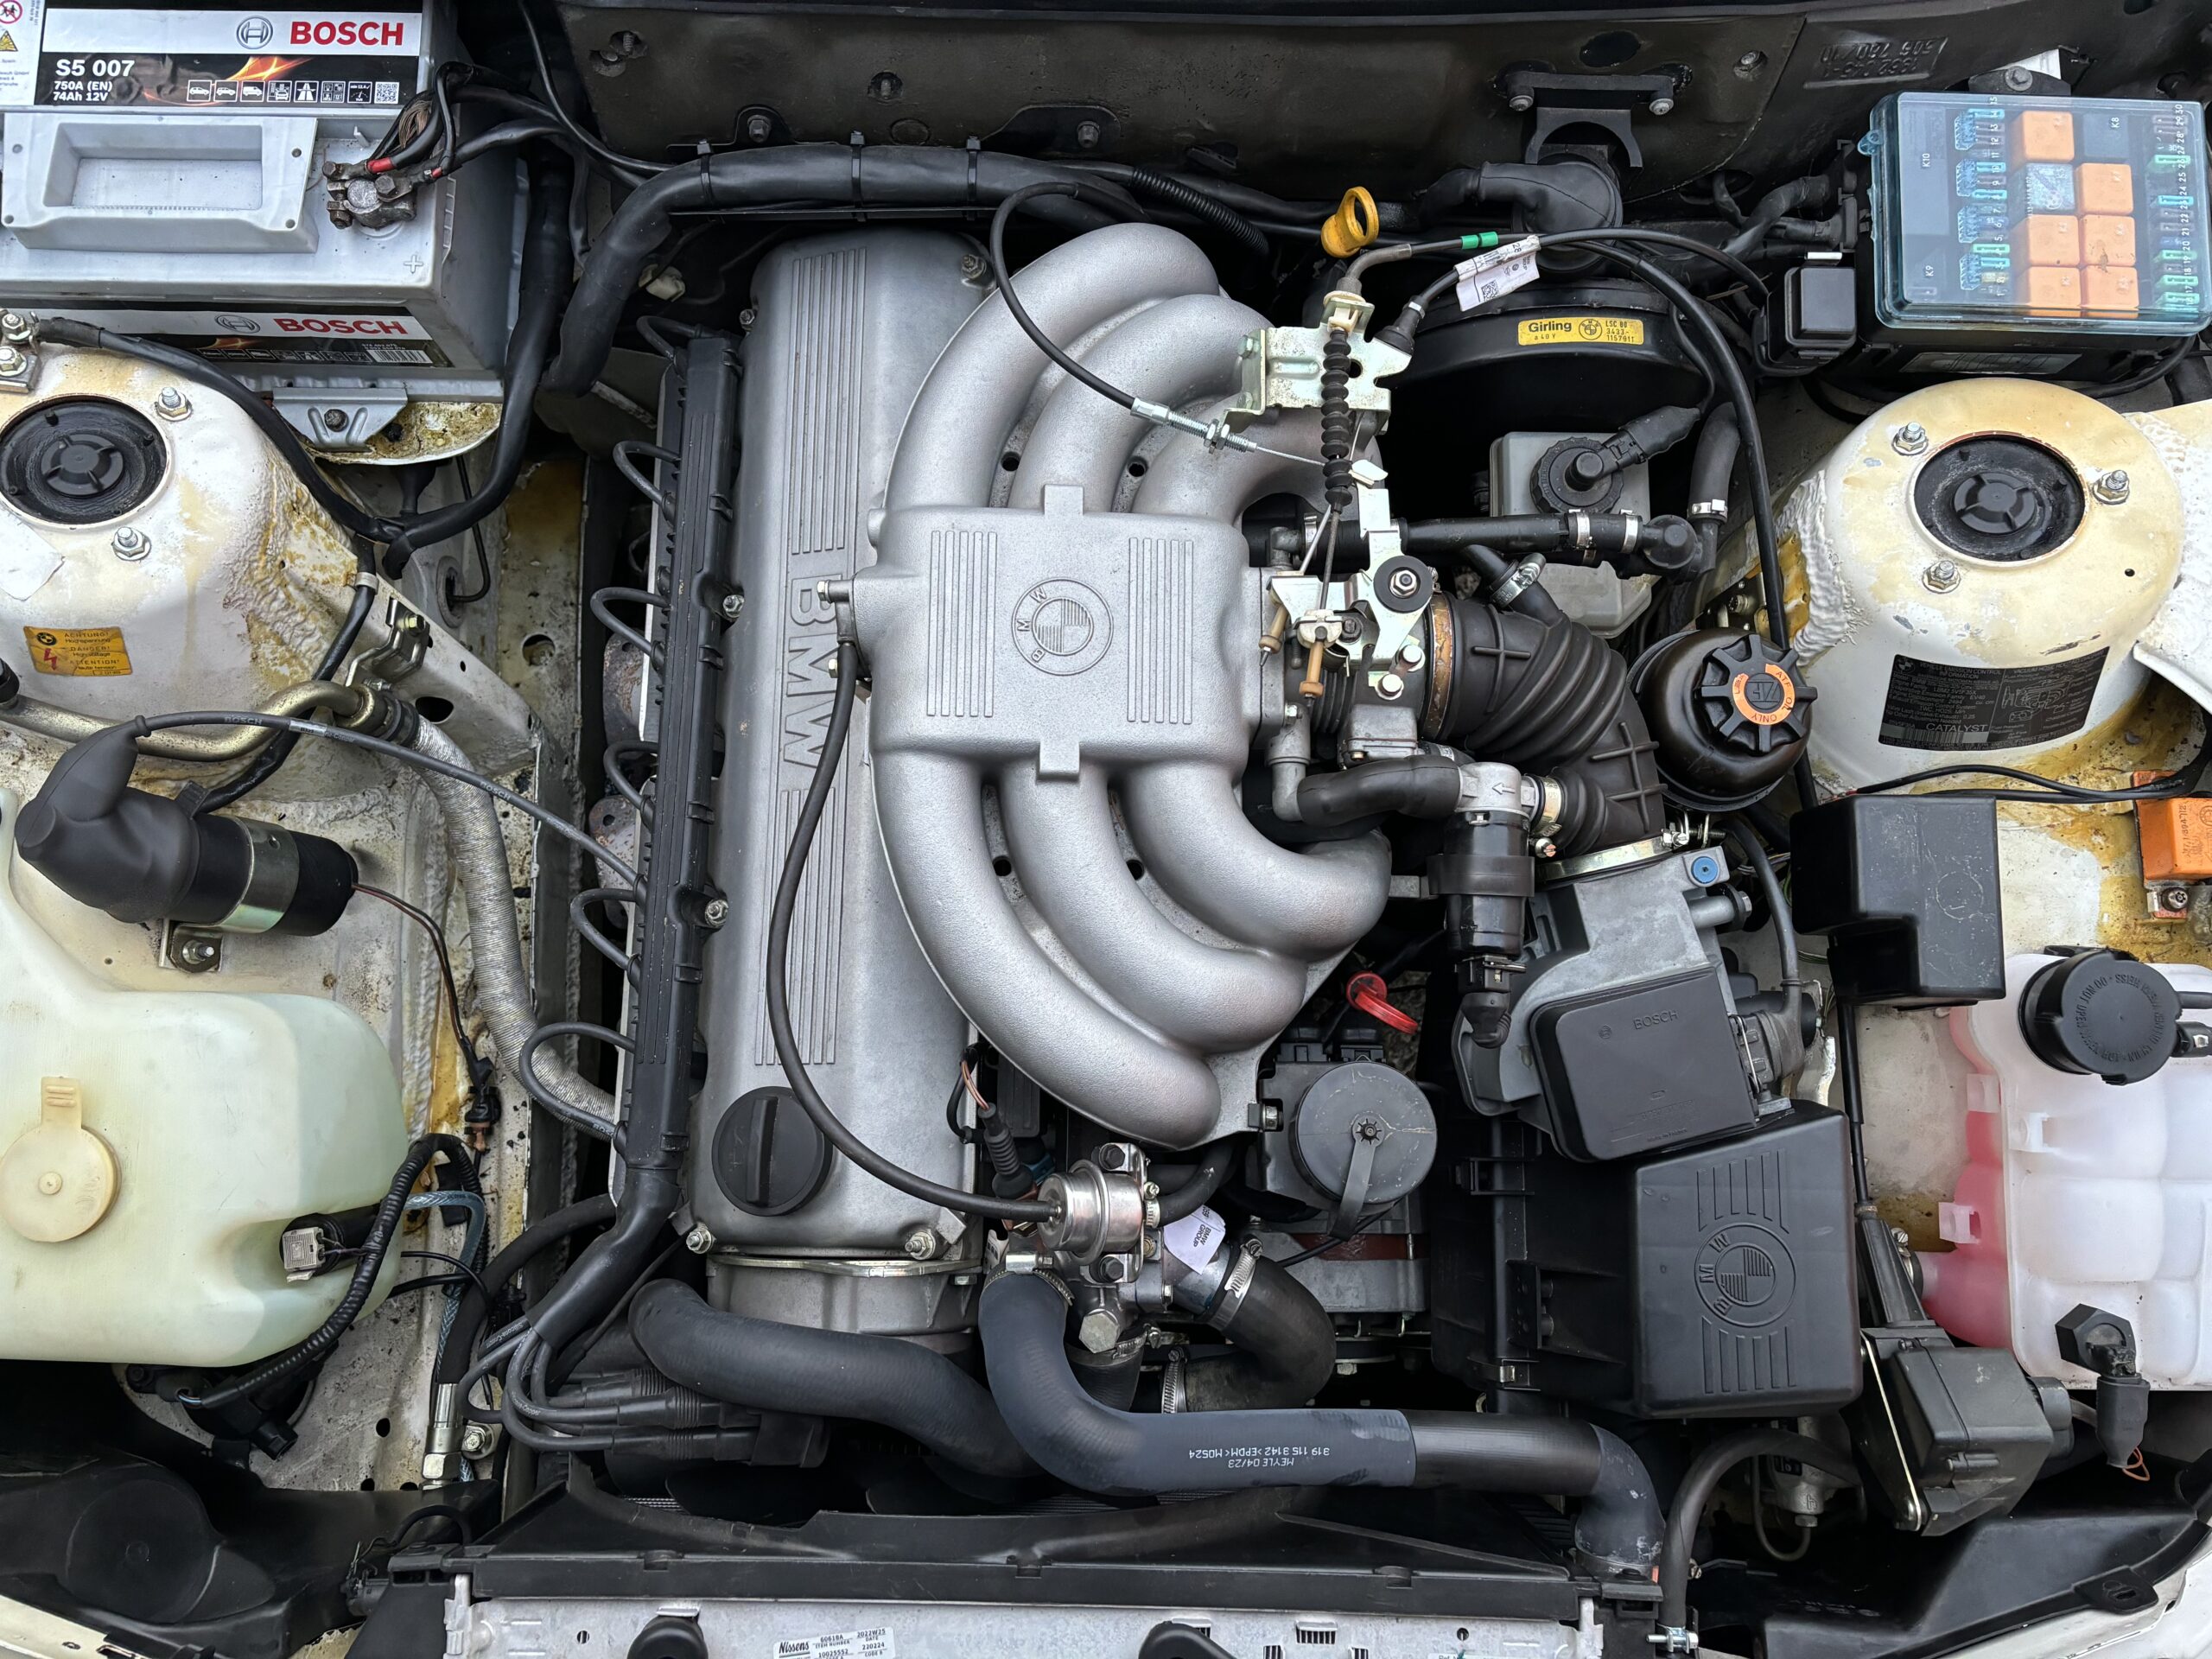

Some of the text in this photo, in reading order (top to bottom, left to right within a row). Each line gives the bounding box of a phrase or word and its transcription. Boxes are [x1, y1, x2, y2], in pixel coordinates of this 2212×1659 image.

[290, 21, 404, 46] BOSCH
[55, 59, 135, 77] S5 007
[54, 80, 113, 92] 750A (EN)
[53, 91, 108, 102] 74Ah 12V
[2176, 104, 2183, 114] 30
[2111, 117, 2120, 129] K8
[2177, 133, 2184, 143] 28
[2177, 145, 2185, 155] 27
[2178, 158, 2185, 168] 26
[2179, 172, 2186, 182] 25
[2179, 186, 2186, 196] 24
[2181, 213, 2189, 223] 22
[2182, 227, 2190, 236] 21
[1512, 243, 1522, 253] 28
[2183, 241, 2190, 251] 20
[1925, 265, 1934, 276] K9
[274, 316, 408, 334] BOSCH
[1529, 321, 1572, 333] Girling
[1017, 587, 1047, 663] BMW
[783, 572, 842, 771] BMW
[1751, 671, 1793, 722] ATF OIL ONLY
[225, 716, 263, 726] BOSCH
[1926, 723, 1989, 733] CATALYST
[480, 781, 511, 801] BOSCH
[2094, 976, 2107, 989] DO
[2079, 985, 2096, 1004] NOT
[1633, 1009, 1679, 1030] BOSCH
[1193, 1224, 1206, 1248] GROUP
[1200, 1227, 1211, 1245] BMW
[1700, 1233, 1732, 1316] BMW
[1225, 1447, 1262, 1458] >EPDM<
[1265, 1446, 1289, 1456] 3142
[1293, 1446, 1308, 1456] 115
[1312, 1447, 1330, 1456] 319
[1228, 1458, 1294, 1468] MEYLE 04/23
[820, 1634, 844, 1643] 60618A
[857, 1628, 886, 1638] 2022W25
[779, 1641, 810, 1654] Nissens
[818, 1649, 849, 1659] 10025552
